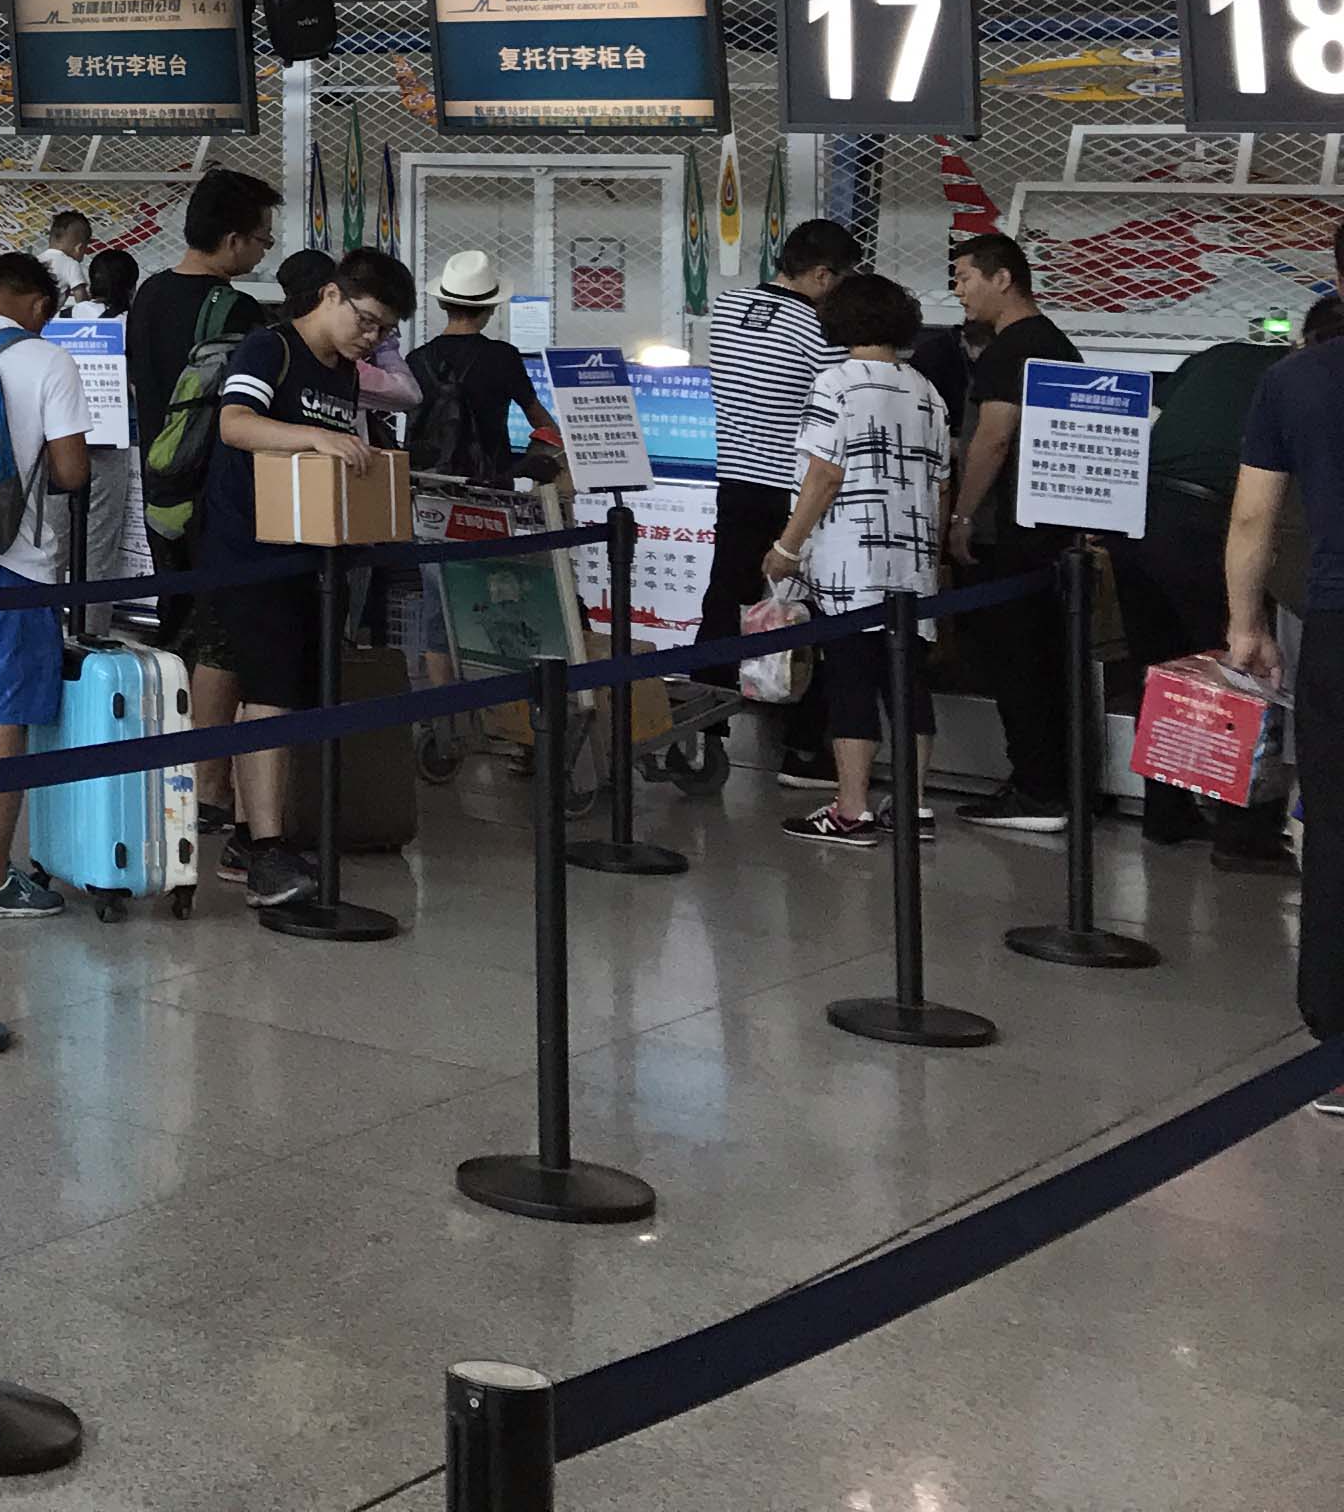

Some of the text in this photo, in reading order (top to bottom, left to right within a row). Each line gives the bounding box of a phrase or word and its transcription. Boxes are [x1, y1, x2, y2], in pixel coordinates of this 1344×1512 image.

[66, 53, 187, 78] 复托行李柜台
[498, 45, 647, 71] 复托行李柜台
